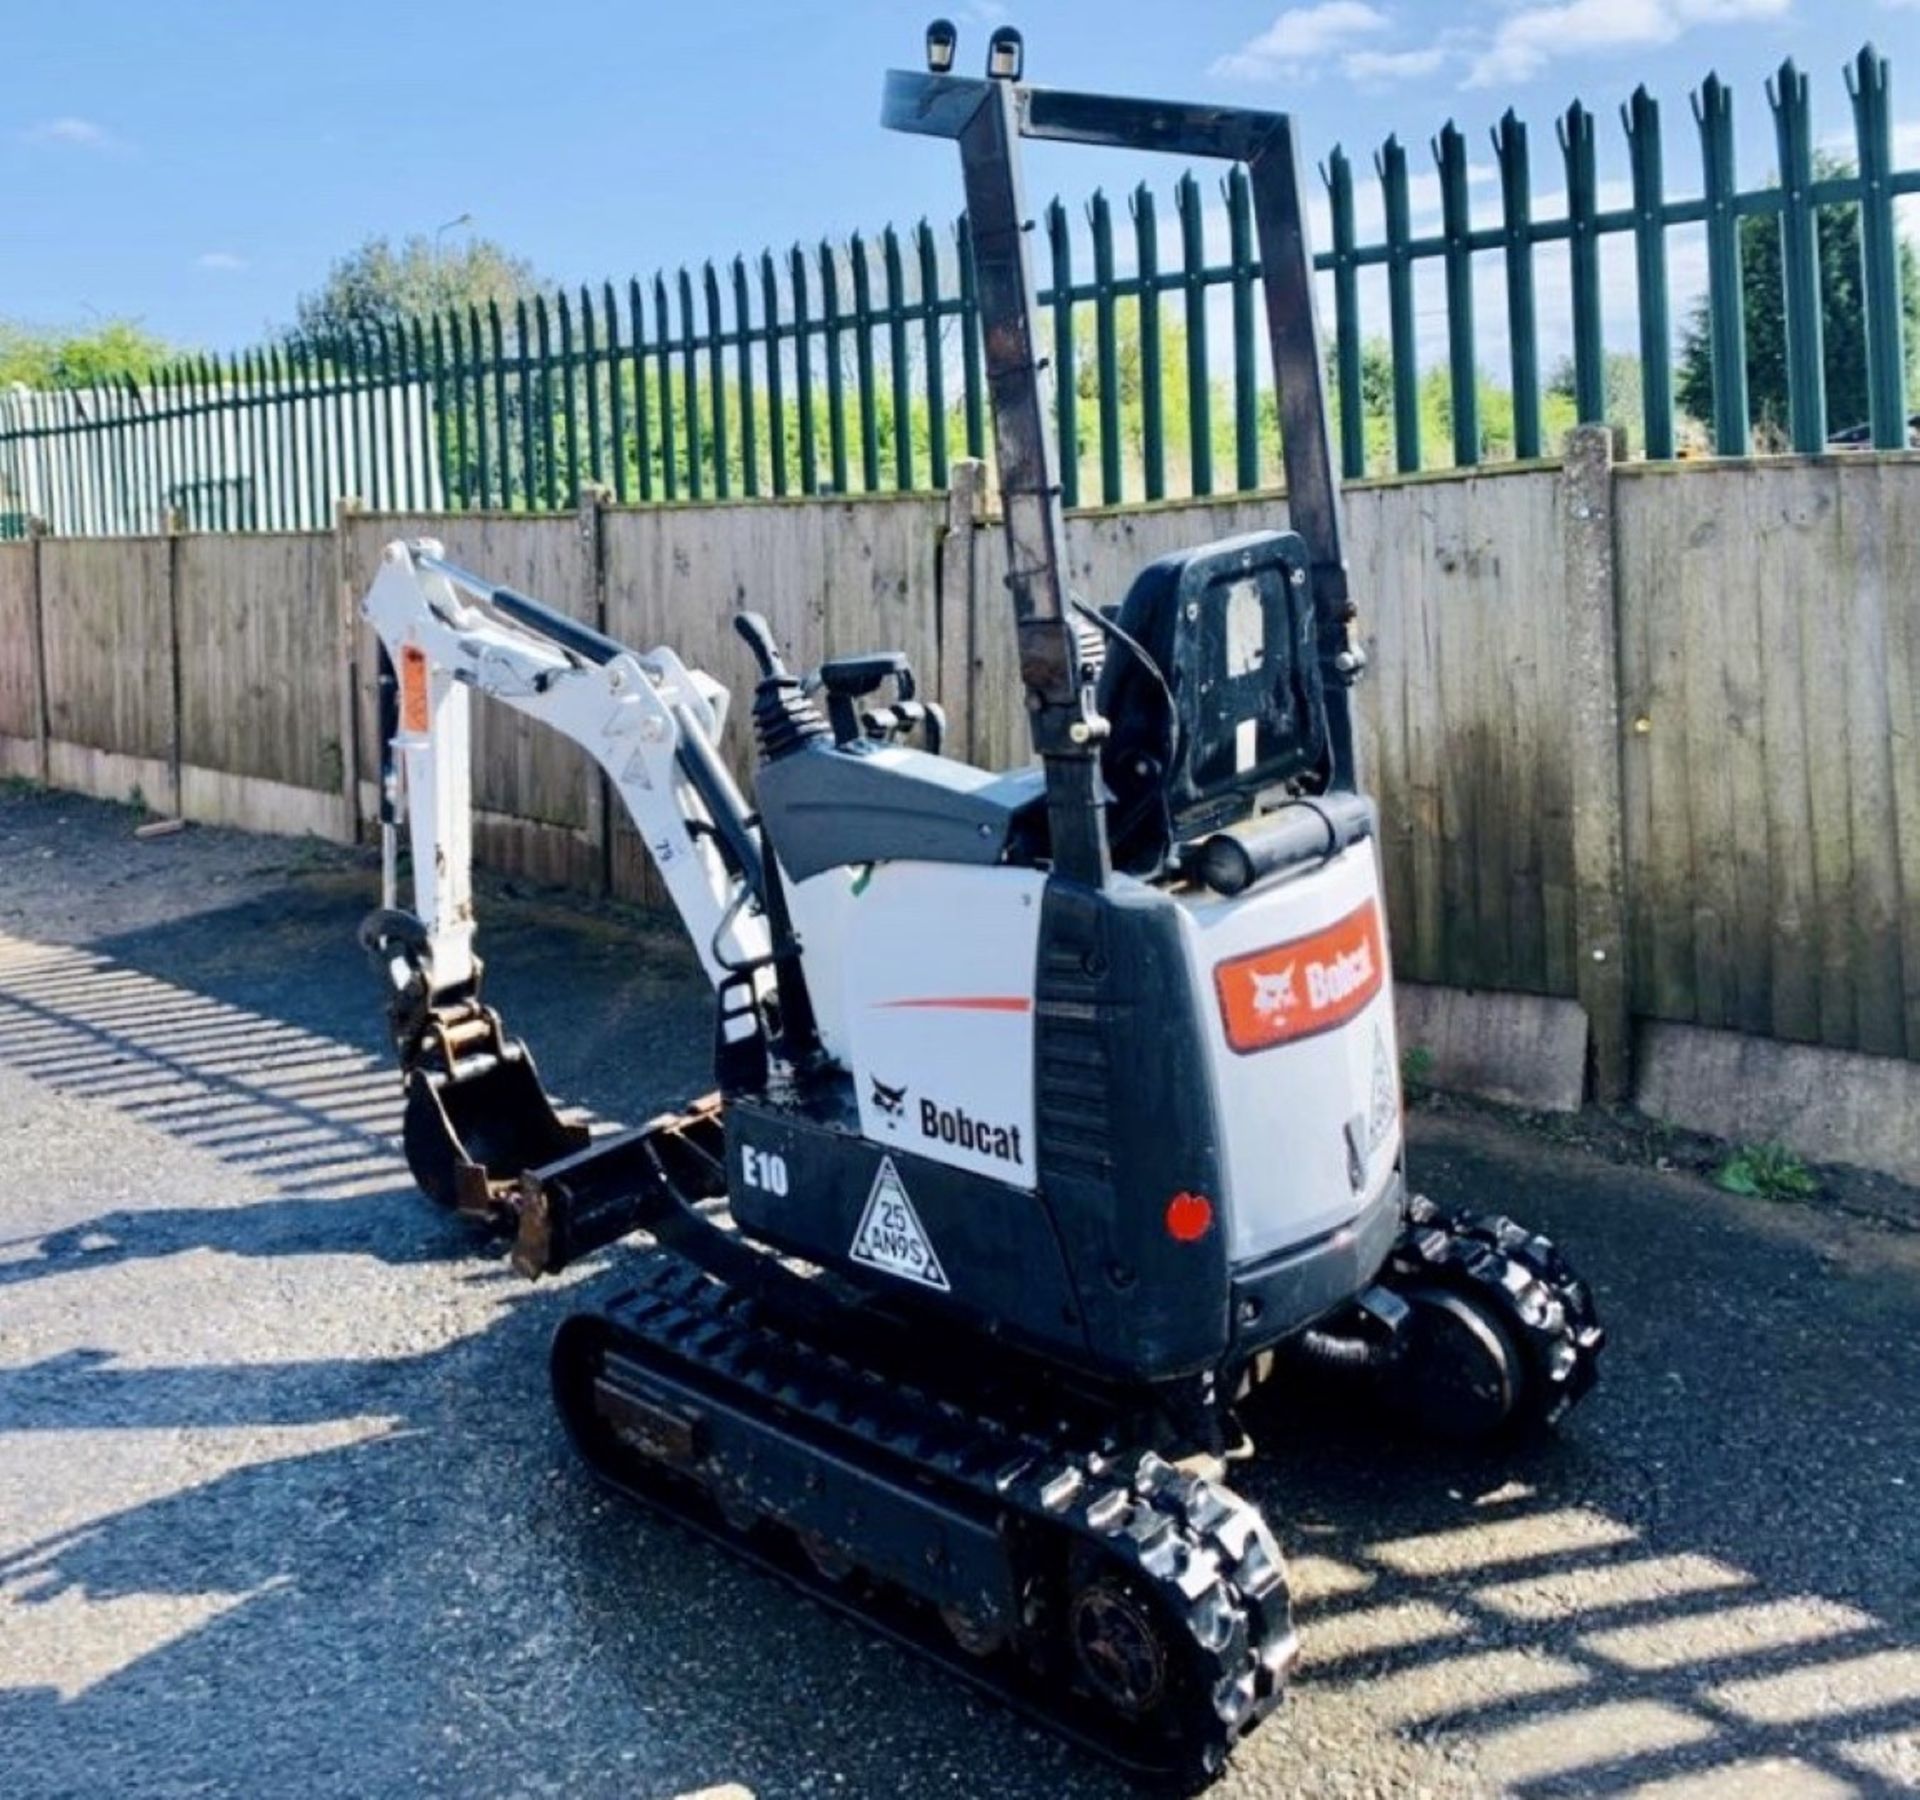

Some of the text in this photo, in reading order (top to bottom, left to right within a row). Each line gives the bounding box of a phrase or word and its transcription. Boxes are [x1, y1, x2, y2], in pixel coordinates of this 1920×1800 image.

[919, 1098, 1023, 1165] Bobcat
[741, 1145, 789, 1197] E10
[880, 1200, 906, 1232] 25
